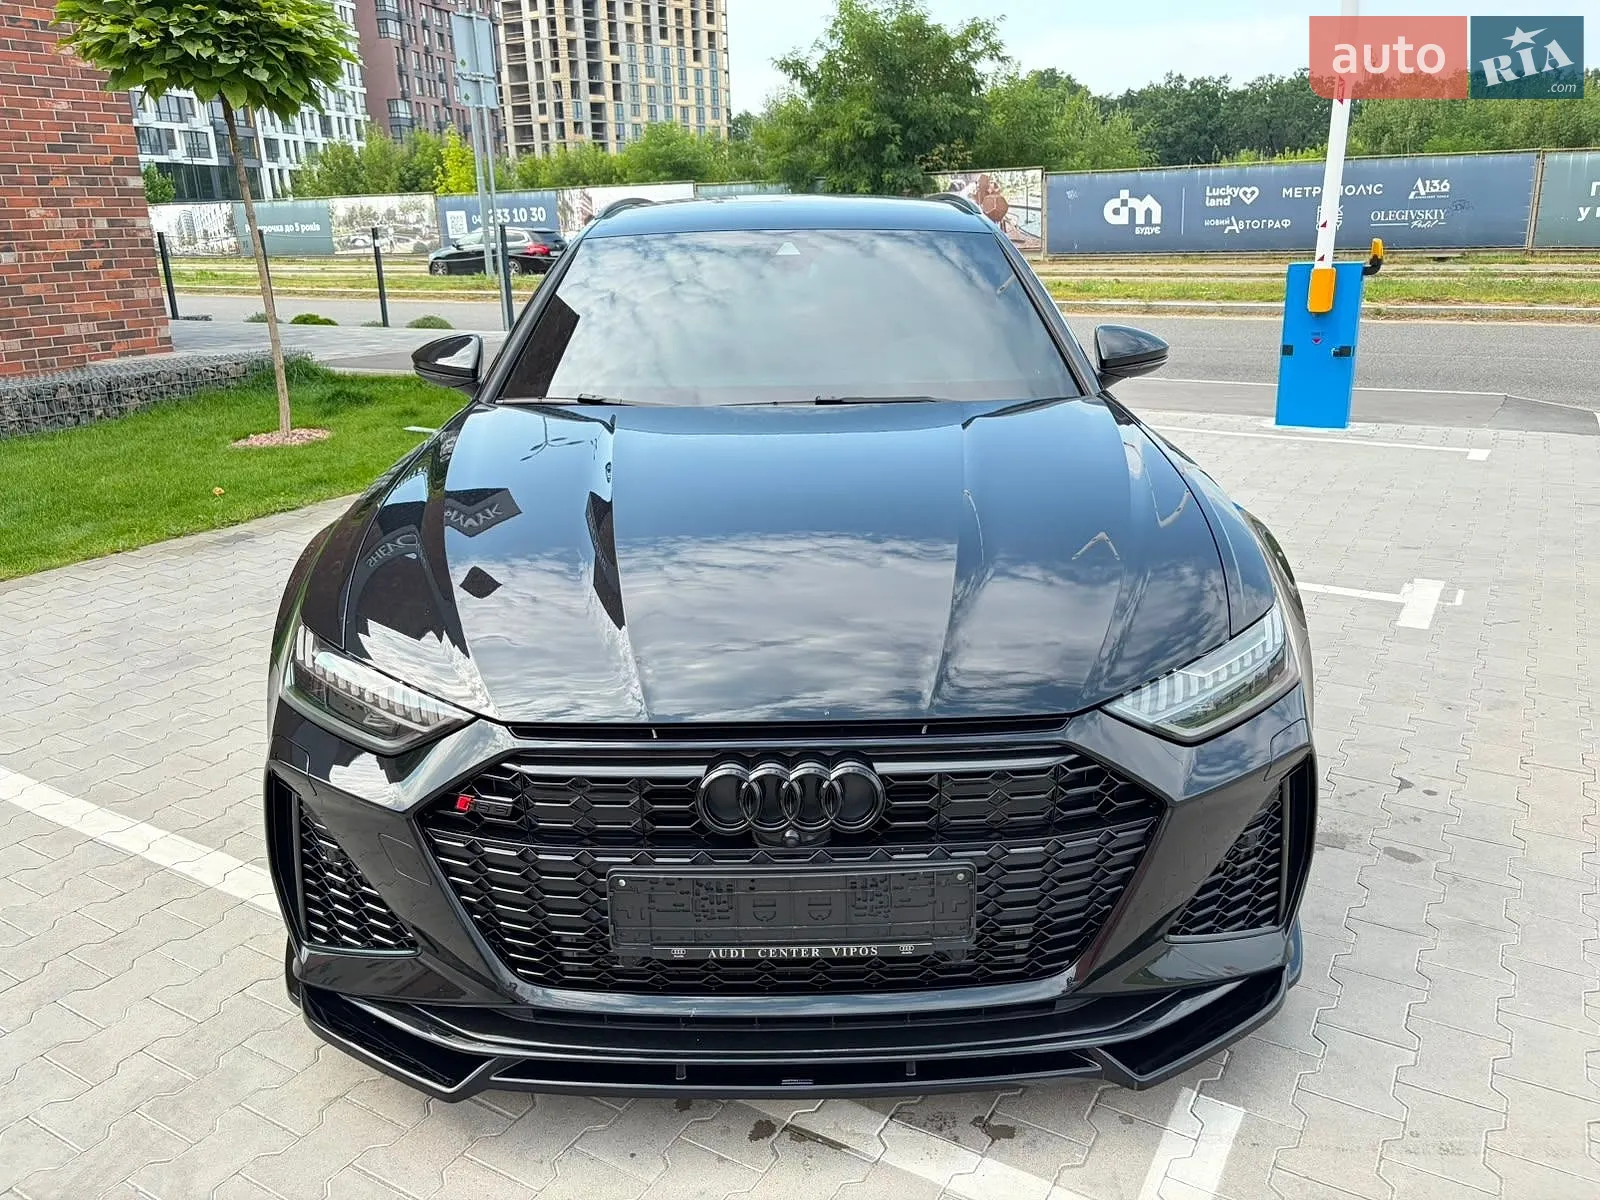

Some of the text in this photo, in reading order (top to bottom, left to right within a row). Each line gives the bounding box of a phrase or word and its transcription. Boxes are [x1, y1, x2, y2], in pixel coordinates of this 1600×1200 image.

[1205, 185, 1240, 198] Lucky
[1205, 196, 1231, 207] land
[513, 207, 528, 222] 10
[530, 206, 547, 222] 30
[1370, 209, 1447, 221] OLEGIVSKIY
[284, 224, 294, 233] до
[294, 222, 300, 232] 5
[1135, 226, 1161, 235] БУДУЄ
[708, 945, 879, 959] AUDI CENTER VIPOS
